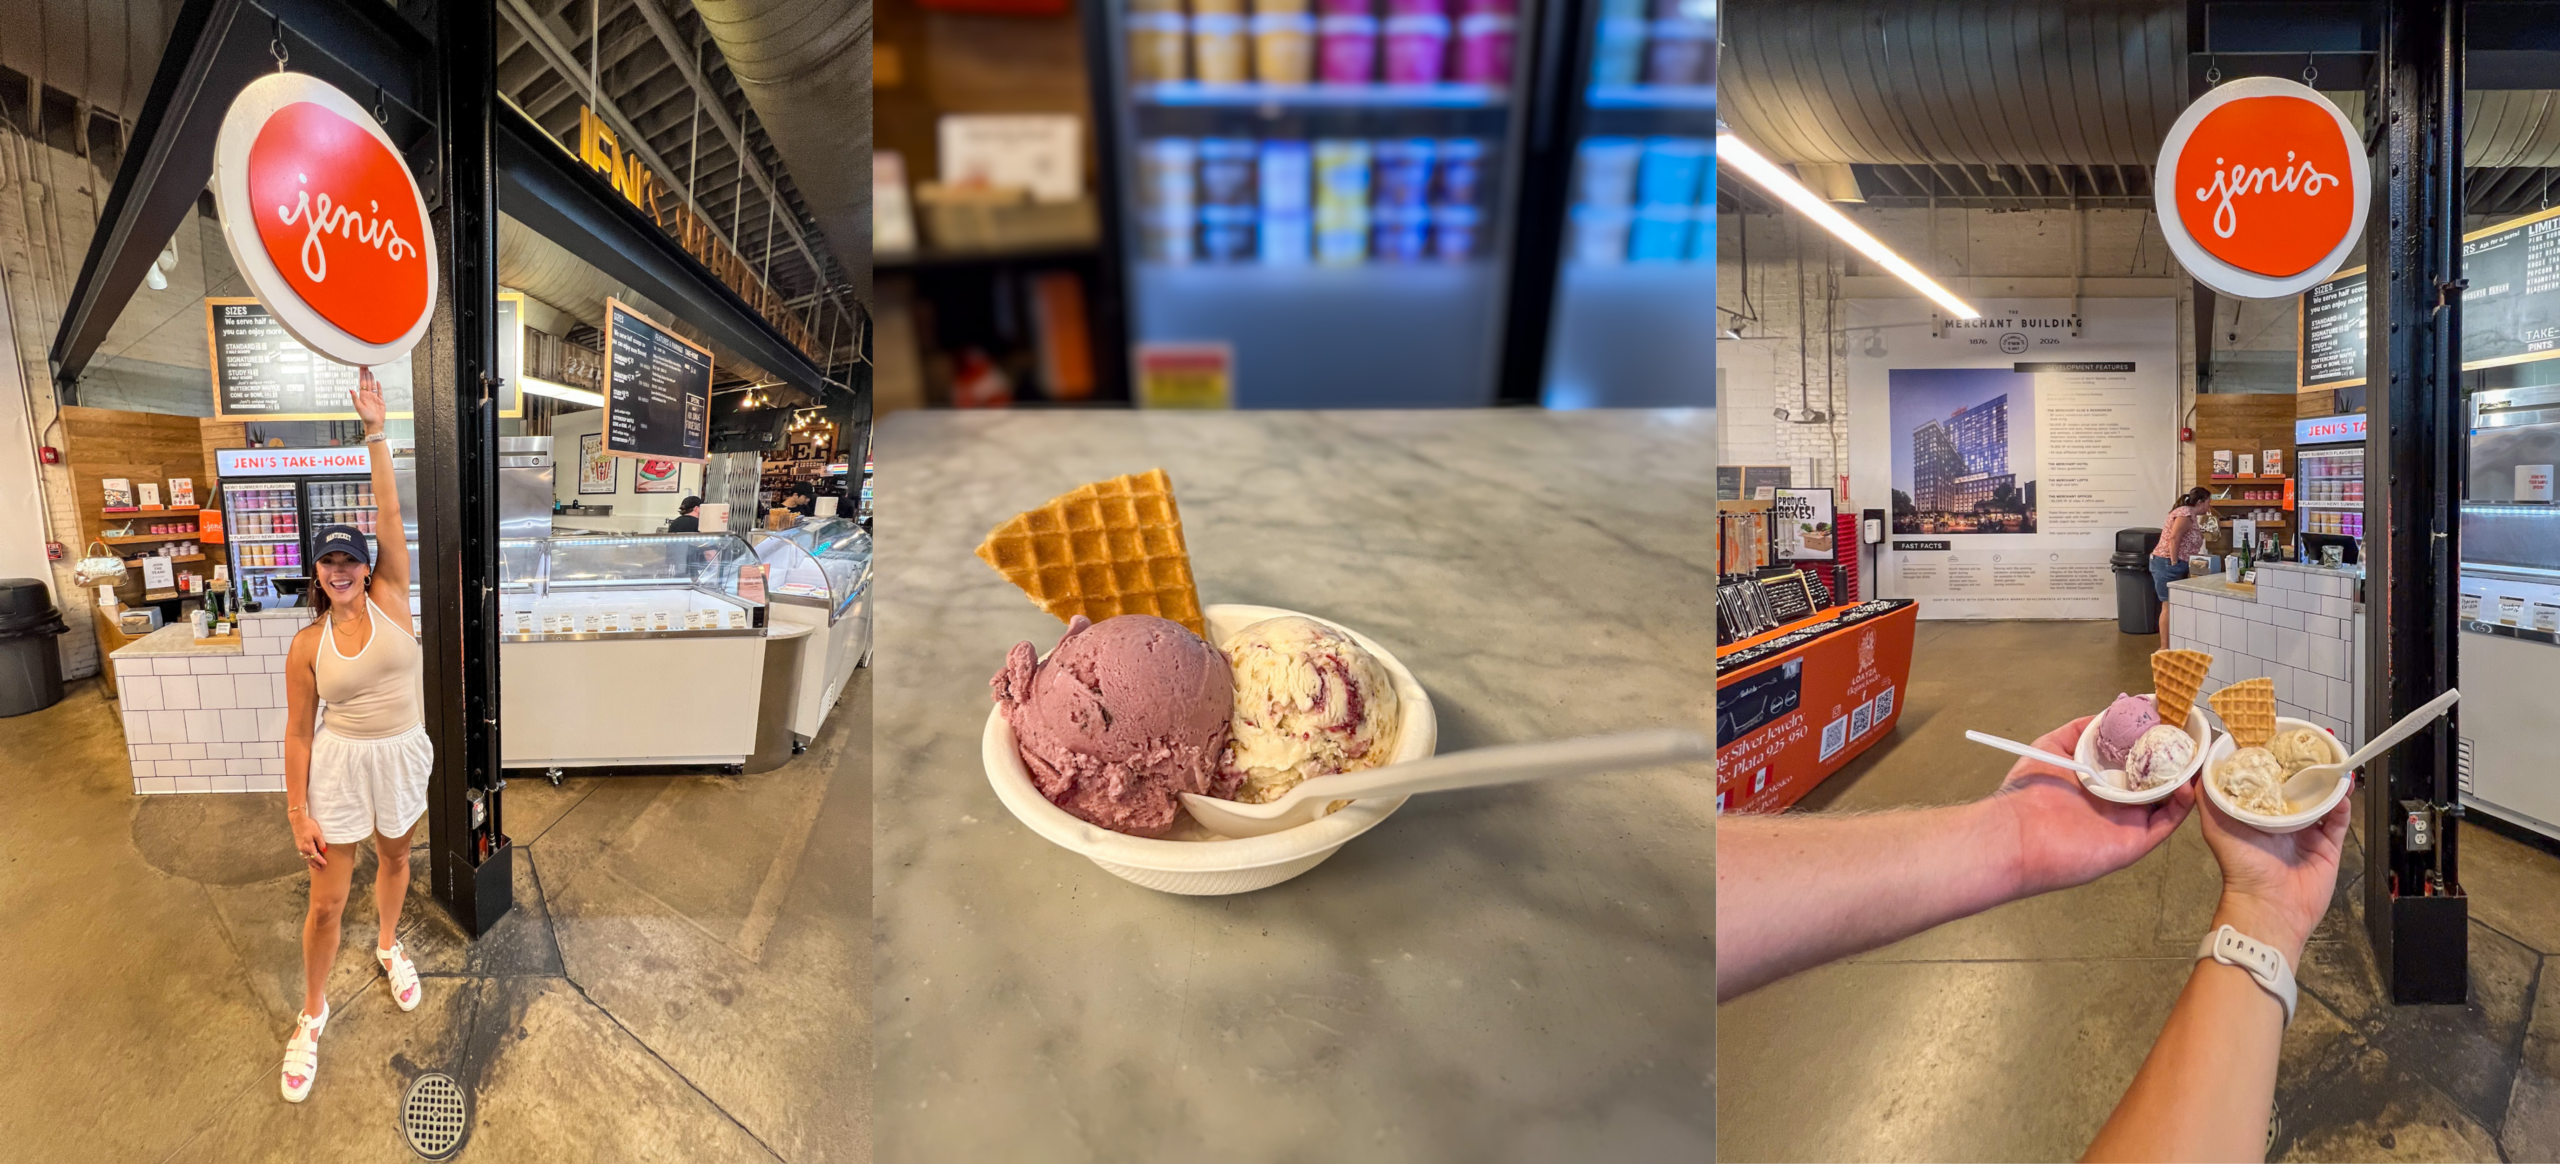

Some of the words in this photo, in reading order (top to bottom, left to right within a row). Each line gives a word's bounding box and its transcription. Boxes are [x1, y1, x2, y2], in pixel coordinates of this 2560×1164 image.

[2315, 283, 2333, 295] SIZES
[2339, 289, 2349, 297] half
[225, 306, 247, 315] SIZES
[2310, 307, 2320, 315] you
[1945, 319, 2012, 328] MERCHANT
[2021, 319, 2082, 328] BUILDING
[248, 328, 264, 336] enjoy
[2528, 341, 2553, 352] PINTS
[2308, 423, 2347, 436] JENI'S
[233, 457, 277, 469] JENI'S
[282, 455, 365, 467] TAKE-HOME
[1778, 497, 1807, 506] PRODUCE
[1778, 506, 1815, 520] BOXES!
[1852, 667, 1877, 685] LOAYZA
[1731, 734, 1765, 760] Silver
[1765, 712, 1806, 743] Jewelry
[1734, 753, 1764, 778] Plata
